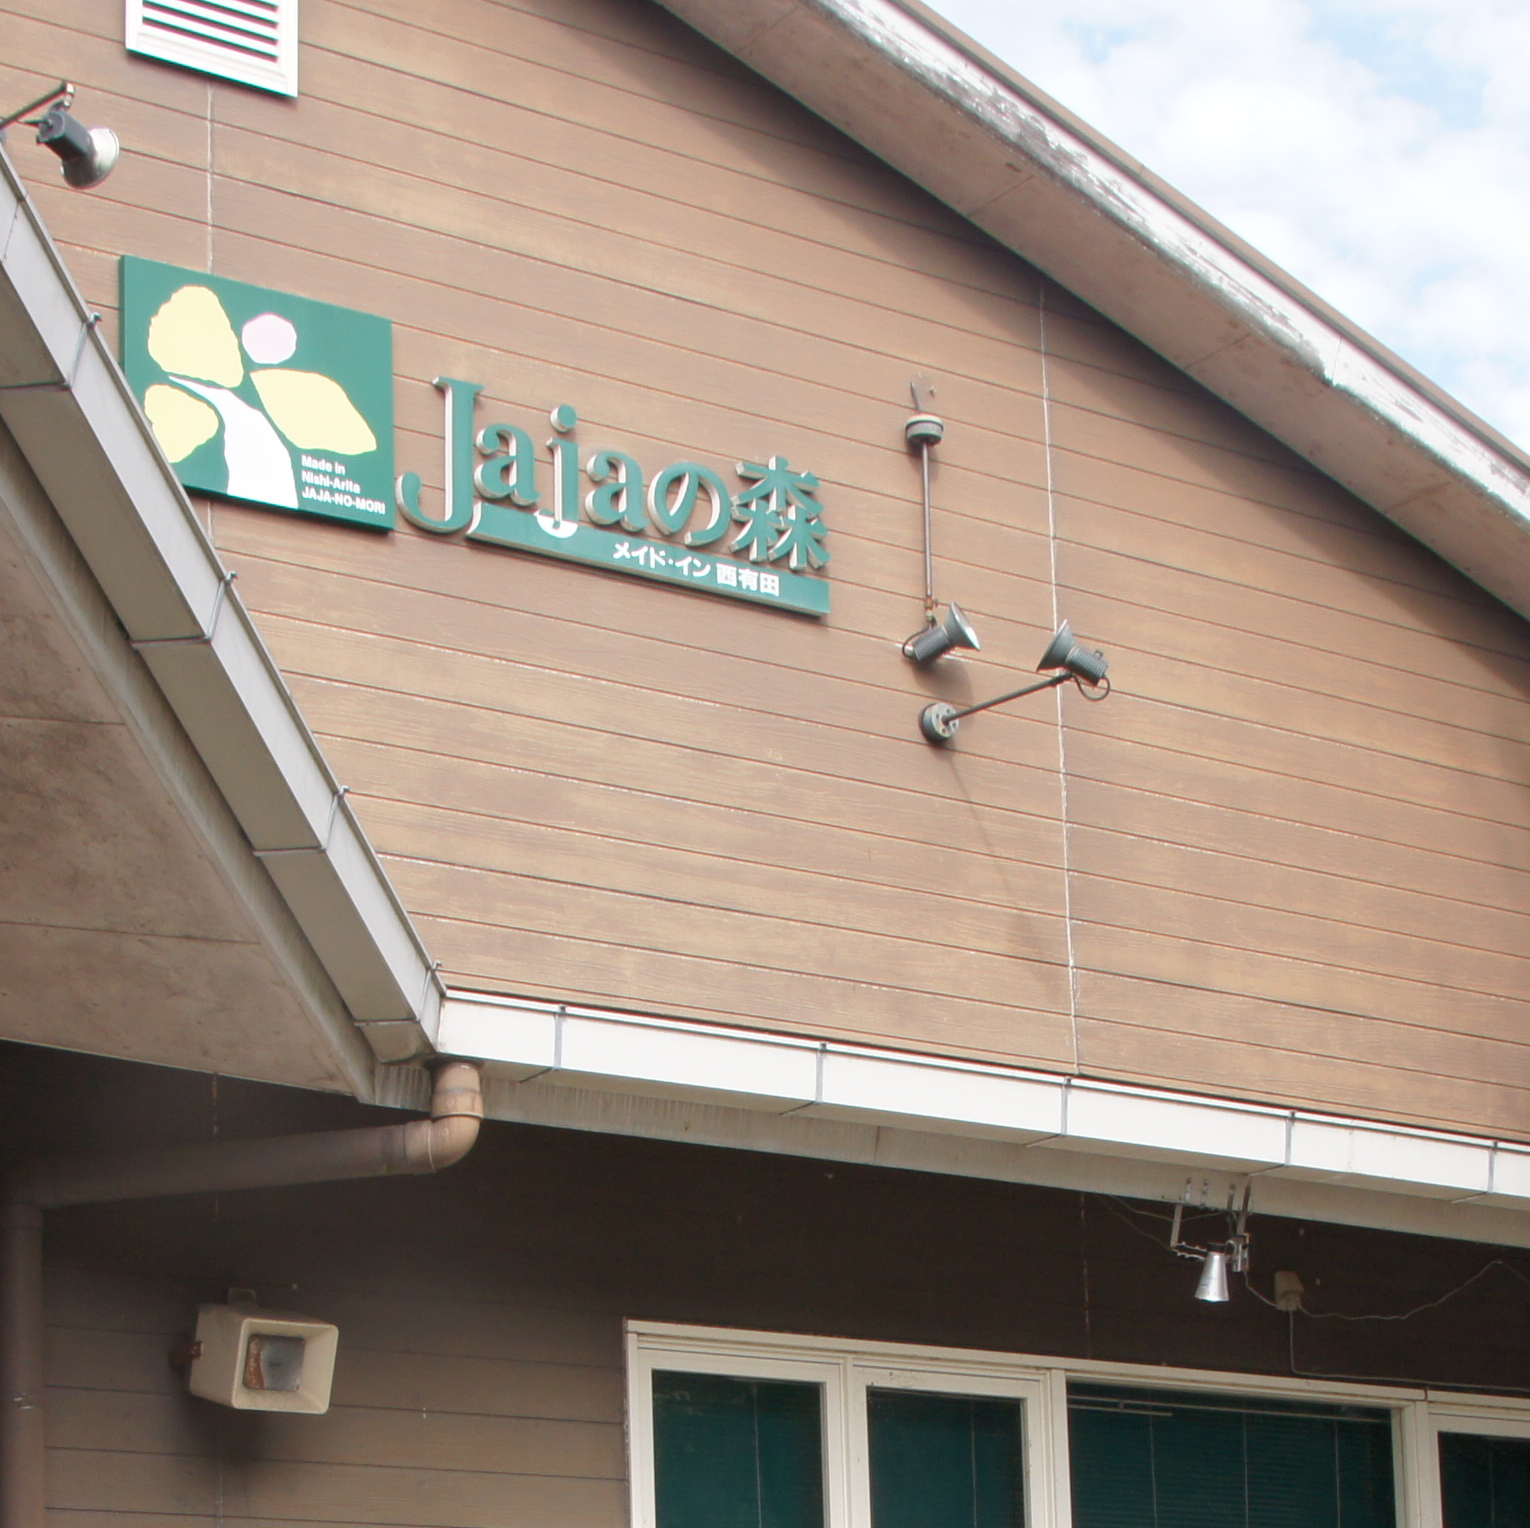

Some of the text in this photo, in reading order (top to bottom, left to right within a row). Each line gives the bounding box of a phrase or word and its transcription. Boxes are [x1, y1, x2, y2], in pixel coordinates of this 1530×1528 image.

[301, 454, 333, 473] Made
[395, 375, 831, 572] Jajaの森
[301, 470, 361, 494] Nishi-Arita
[301, 486, 386, 515] JAJA-NO-MORI
[716, 562, 781, 598] 西有田
